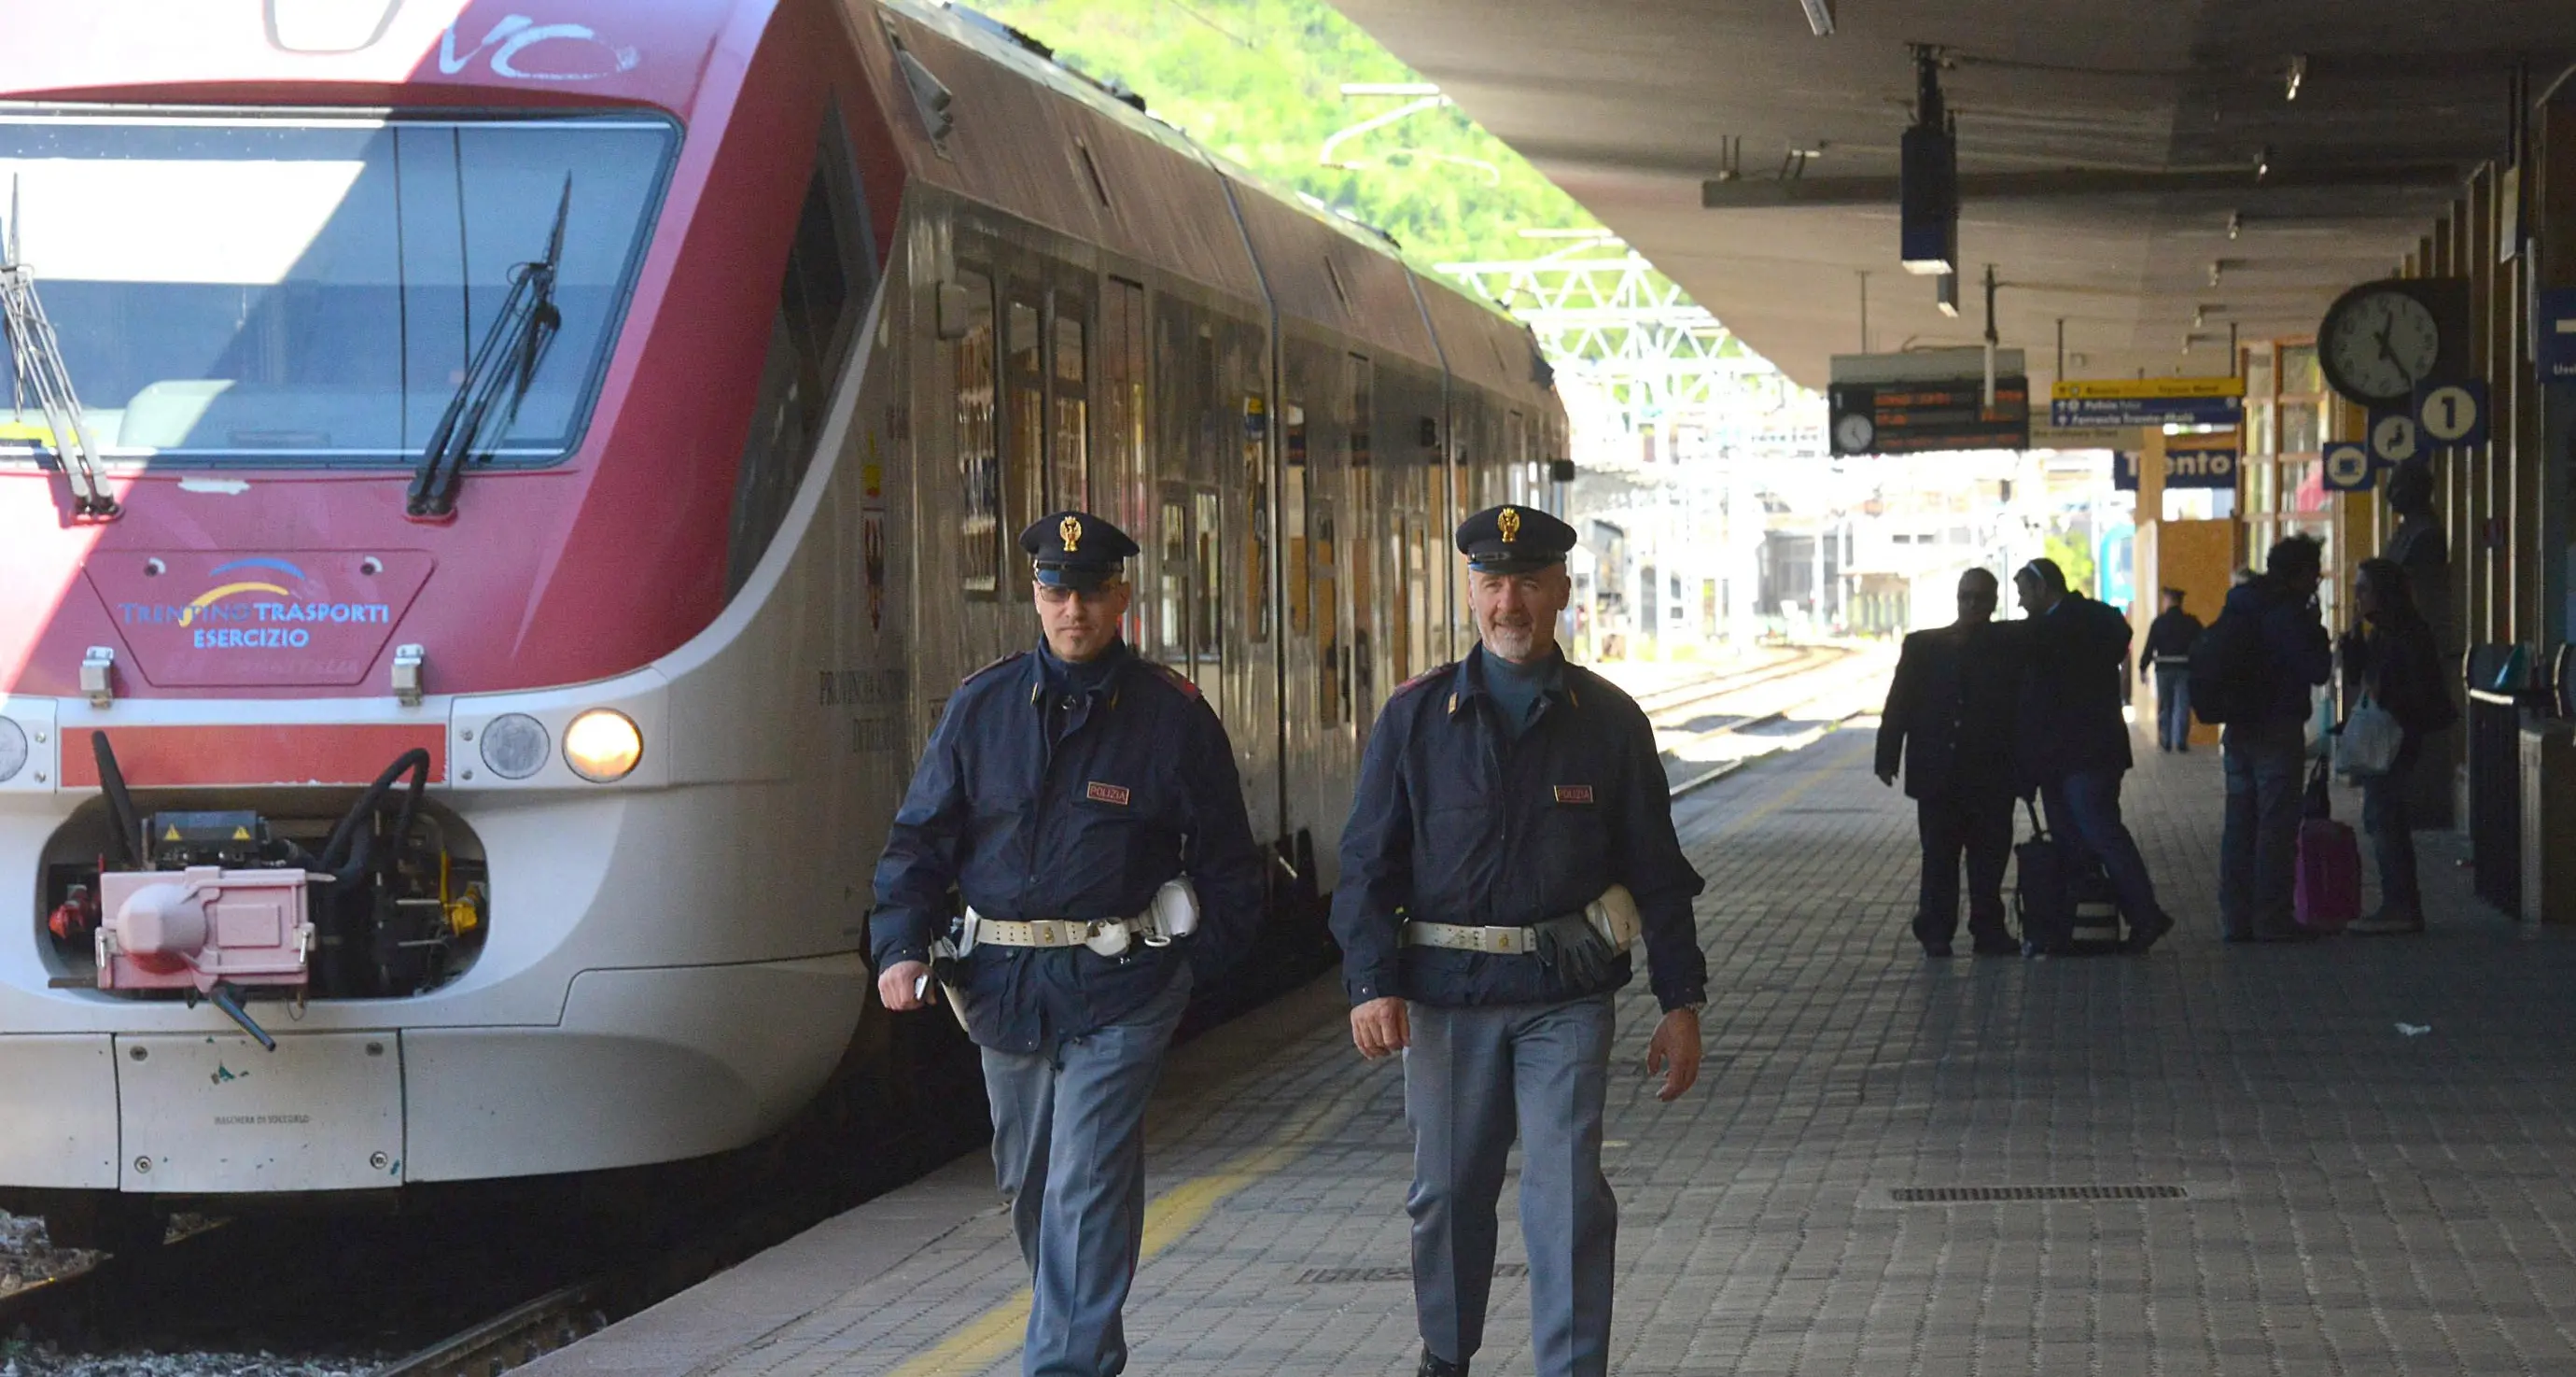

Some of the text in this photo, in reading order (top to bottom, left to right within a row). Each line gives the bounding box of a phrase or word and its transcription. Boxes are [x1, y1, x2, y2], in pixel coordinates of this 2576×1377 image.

[2441, 396, 2457, 429] 1
[2122, 451, 2232, 477] Tento
[119, 602, 389, 625] TRENTINO TRASPORTI
[193, 627, 310, 649] ESERCIZIO
[1089, 785, 1126, 801] POLIZIA
[1557, 789, 1590, 800] POLIZIA
